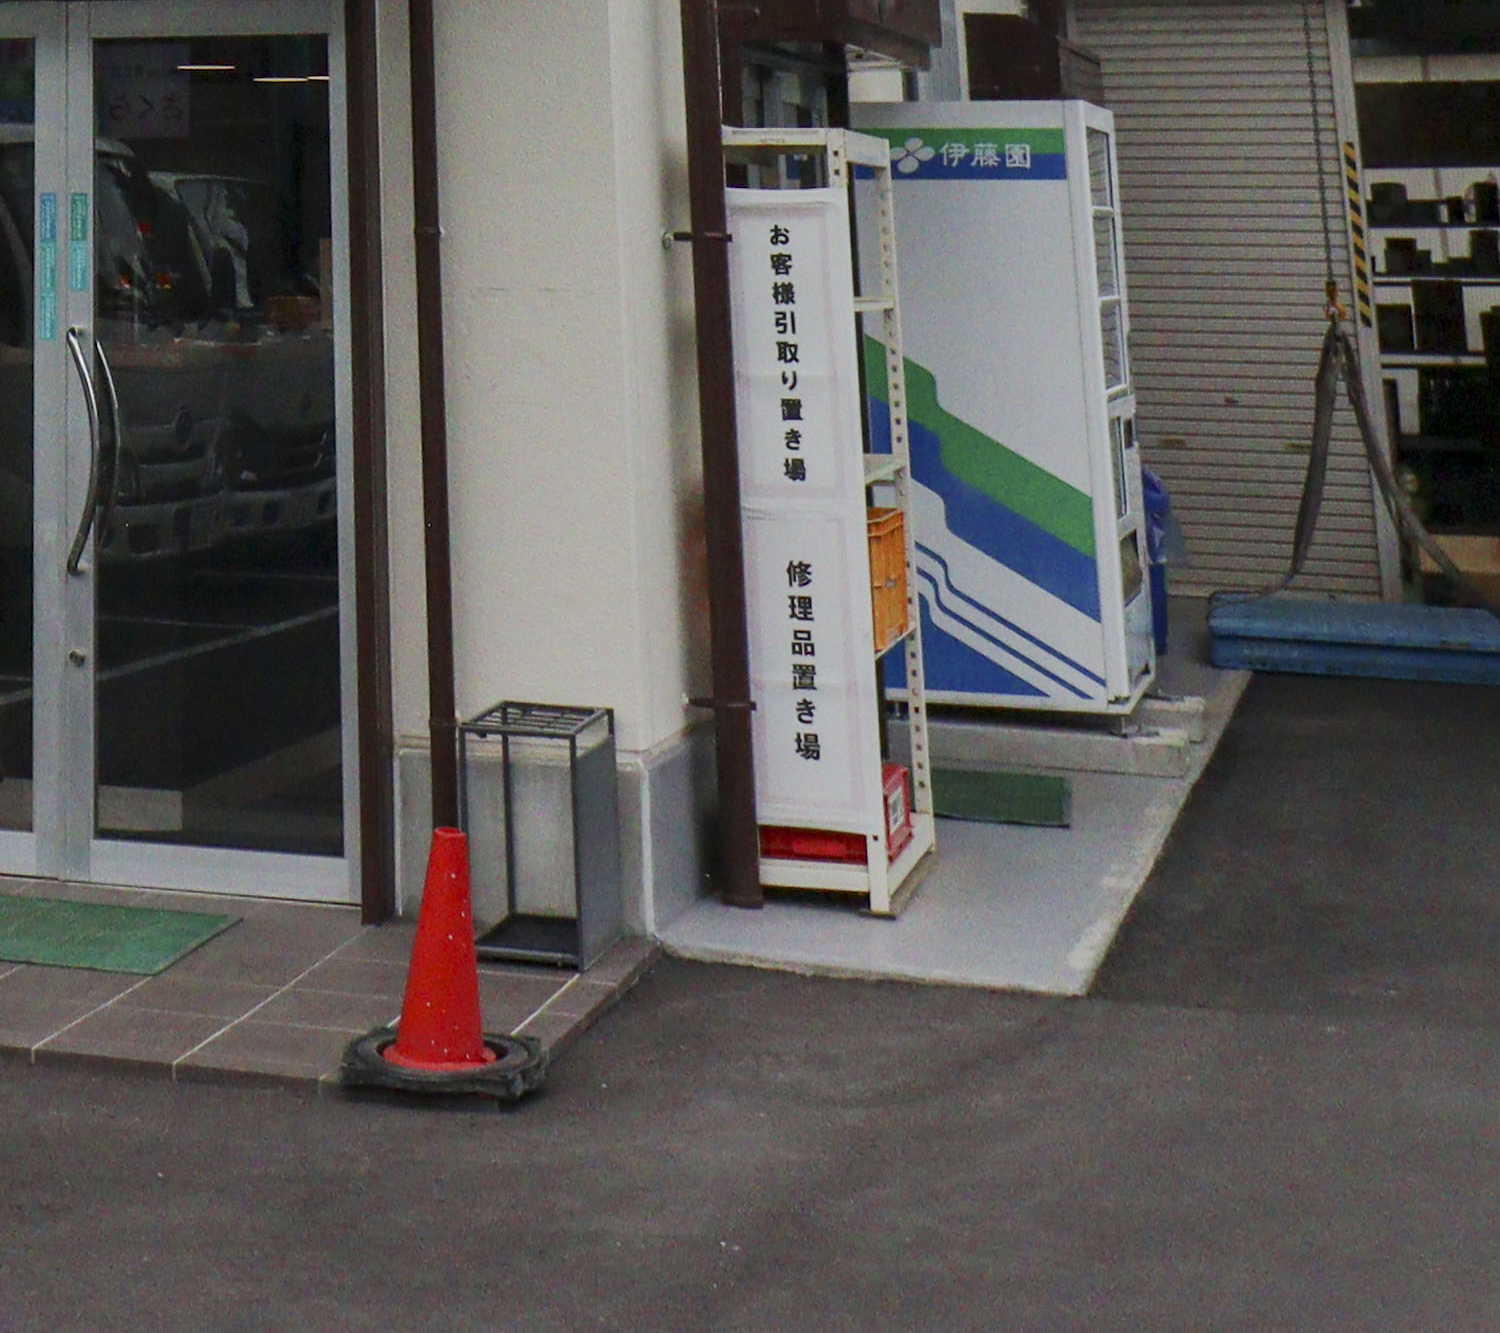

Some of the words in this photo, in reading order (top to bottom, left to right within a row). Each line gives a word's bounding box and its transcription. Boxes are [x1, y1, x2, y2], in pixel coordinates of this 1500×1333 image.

[939, 141, 1032, 170] 伊藤園
[769, 224, 807, 482] お客様引取り置き場
[786, 559, 821, 761] 修理品置き場
